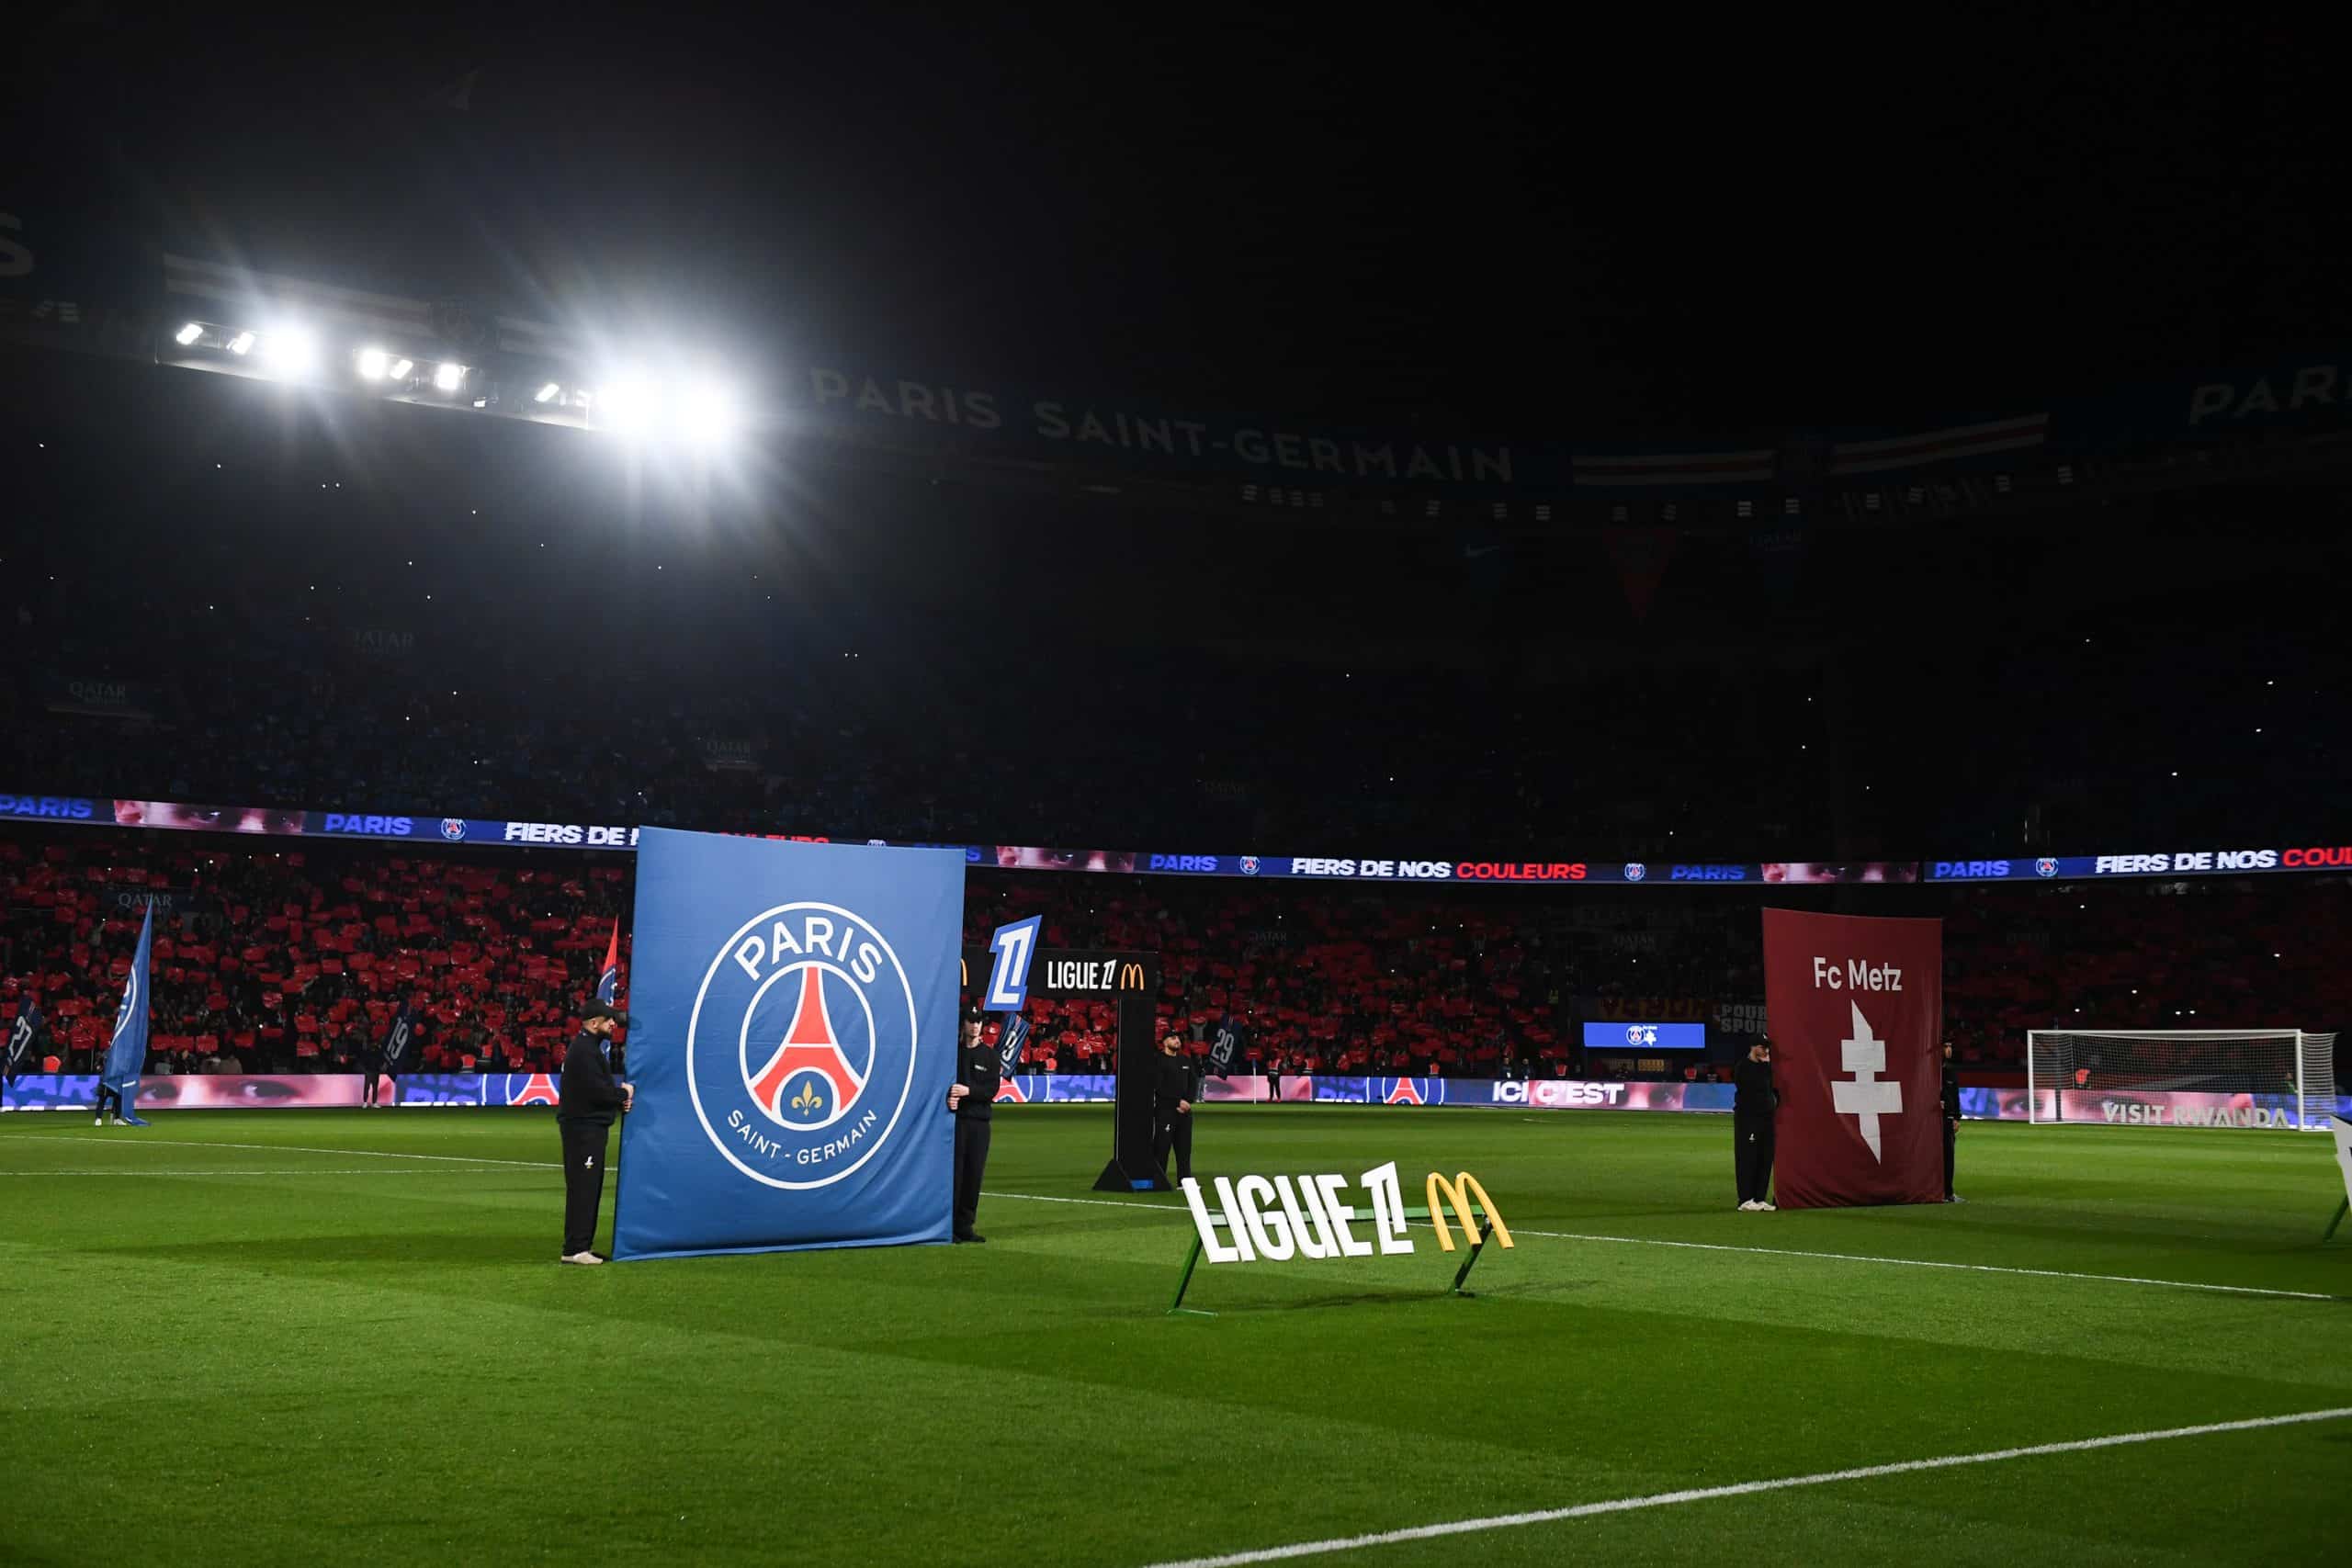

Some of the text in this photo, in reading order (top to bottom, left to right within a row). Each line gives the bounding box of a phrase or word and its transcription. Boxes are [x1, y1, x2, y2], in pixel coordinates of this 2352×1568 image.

[811, 367, 1514, 483] PARIS SAINT-GERMAIN
[69, 682, 125, 699] QATAR
[0, 794, 92, 819] PARIS
[324, 814, 413, 836] PARIS
[505, 822, 585, 845] FIERS
[586, 826, 625, 846] DE
[1149, 854, 1218, 872] PARIS
[1291, 857, 1588, 880] FIERS DE NOS COULEURS
[1670, 865, 1746, 881] PARIS
[1935, 860, 2010, 878] PARIS
[2095, 854, 2170, 874] FIERS
[2173, 852, 2212, 871] DE
[2215, 850, 2278, 870] NOS
[119, 893, 172, 908] QATAR
[733, 917, 883, 984] PARIS
[1814, 956, 1902, 991] Fc Metz
[9, 1015, 32, 1062] 27
[386, 1016, 409, 1059] 19
[1211, 1029, 1235, 1064] 29
[1492, 1081, 1624, 1105] ICI C'EST
[2102, 1102, 2165, 1124] VISIT
[2173, 1106, 2290, 1128] RWANDA
[1181, 1174, 1373, 1264] LIGUE
